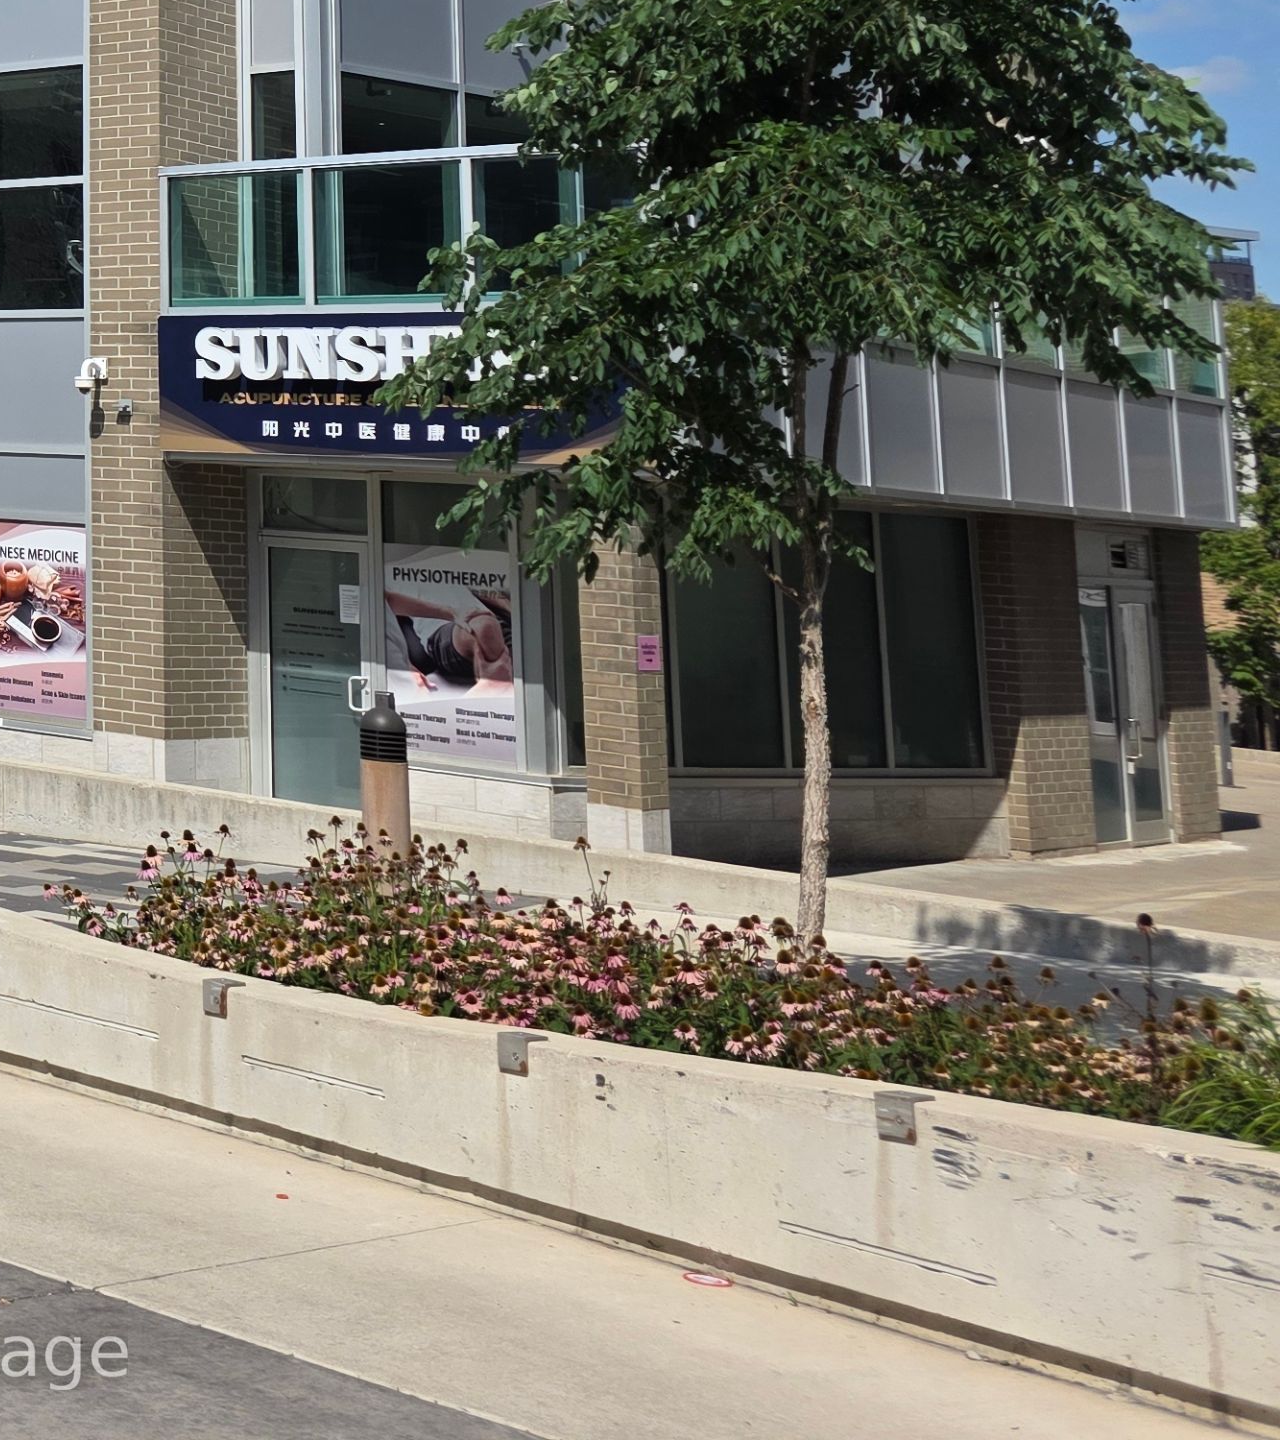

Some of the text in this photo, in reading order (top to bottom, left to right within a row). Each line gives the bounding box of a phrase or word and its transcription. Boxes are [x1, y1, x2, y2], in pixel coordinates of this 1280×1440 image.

[194, 325, 548, 383] SUNSH
[219, 391, 362, 407] ACUPUNCTURE
[27, 547, 79, 563] MEDICINE
[393, 567, 507, 588] PHYSIOTHERAPY
[422, 713, 447, 724] Therapy
[490, 711, 515, 721] Therapy
[426, 733, 450, 744] Therapy
[476, 731, 491, 739] Cold
[491, 732, 517, 743] Therapy
